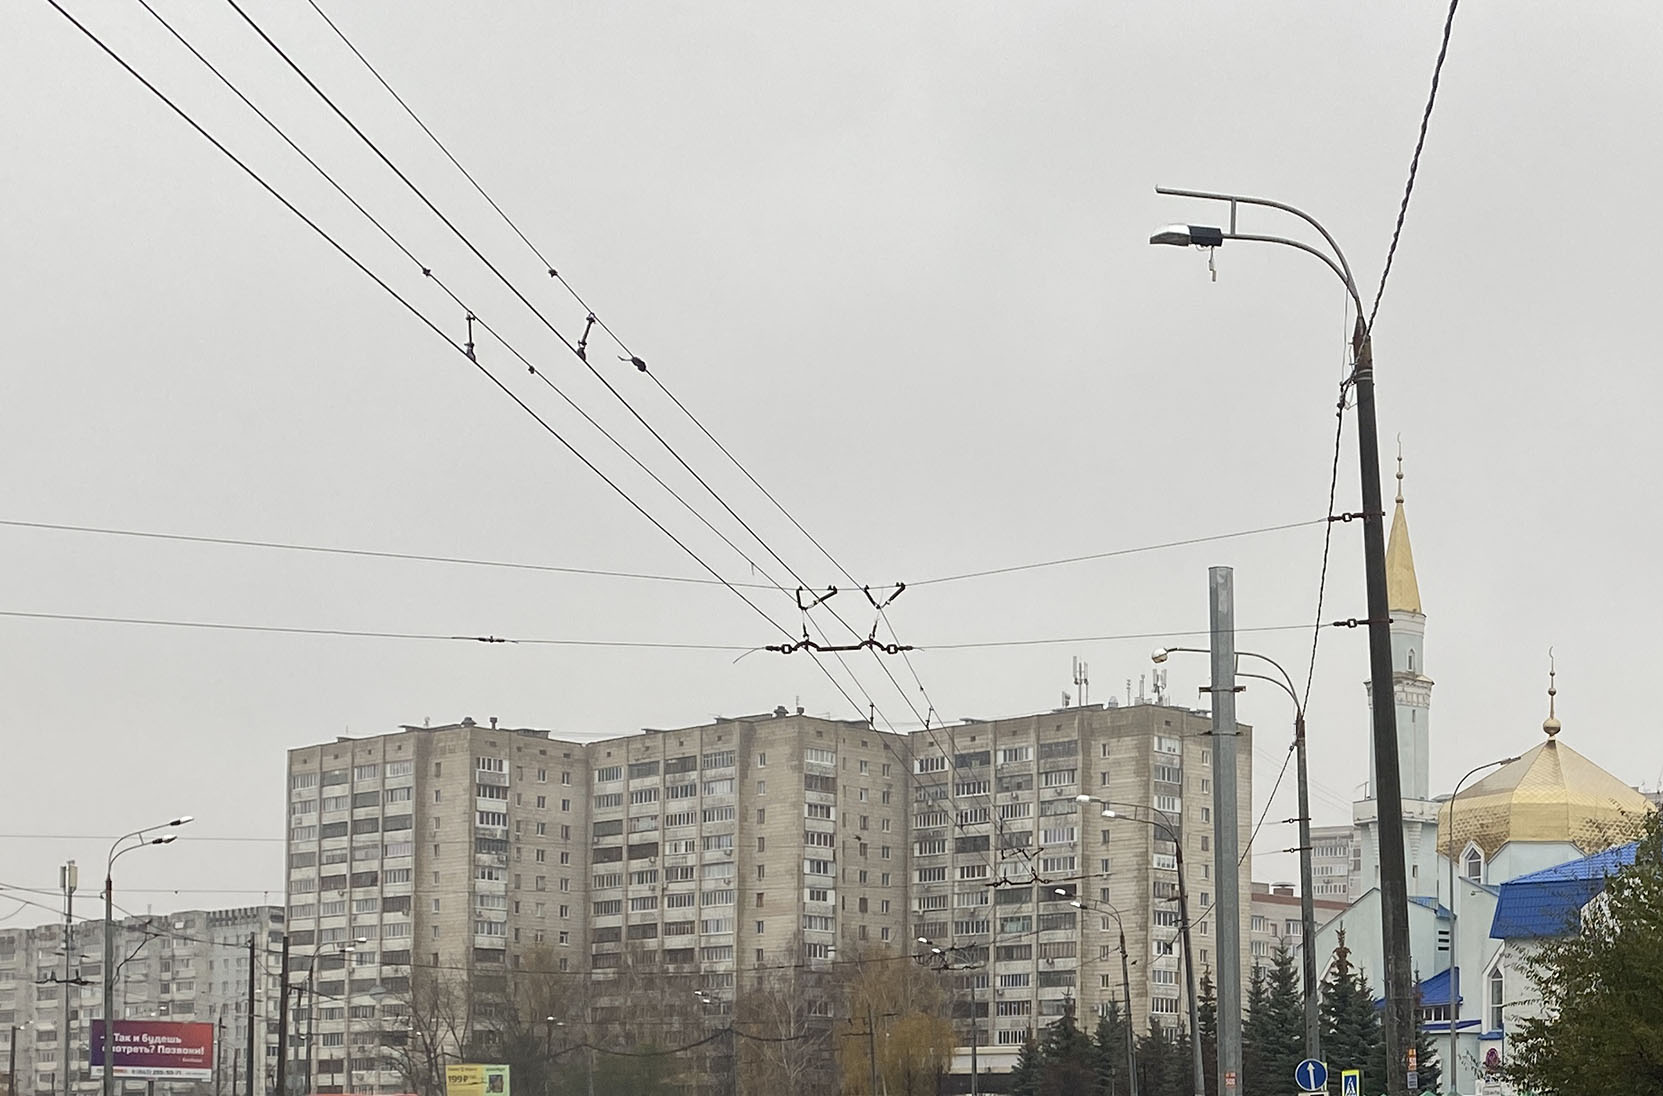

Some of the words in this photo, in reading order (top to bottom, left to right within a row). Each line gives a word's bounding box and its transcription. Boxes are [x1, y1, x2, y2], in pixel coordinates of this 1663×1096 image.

[113, 1033, 131, 1043] Так
[133, 1035, 140, 1043] и
[142, 1033, 182, 1045] будешь
[157, 1045, 205, 1056] Позвони!
